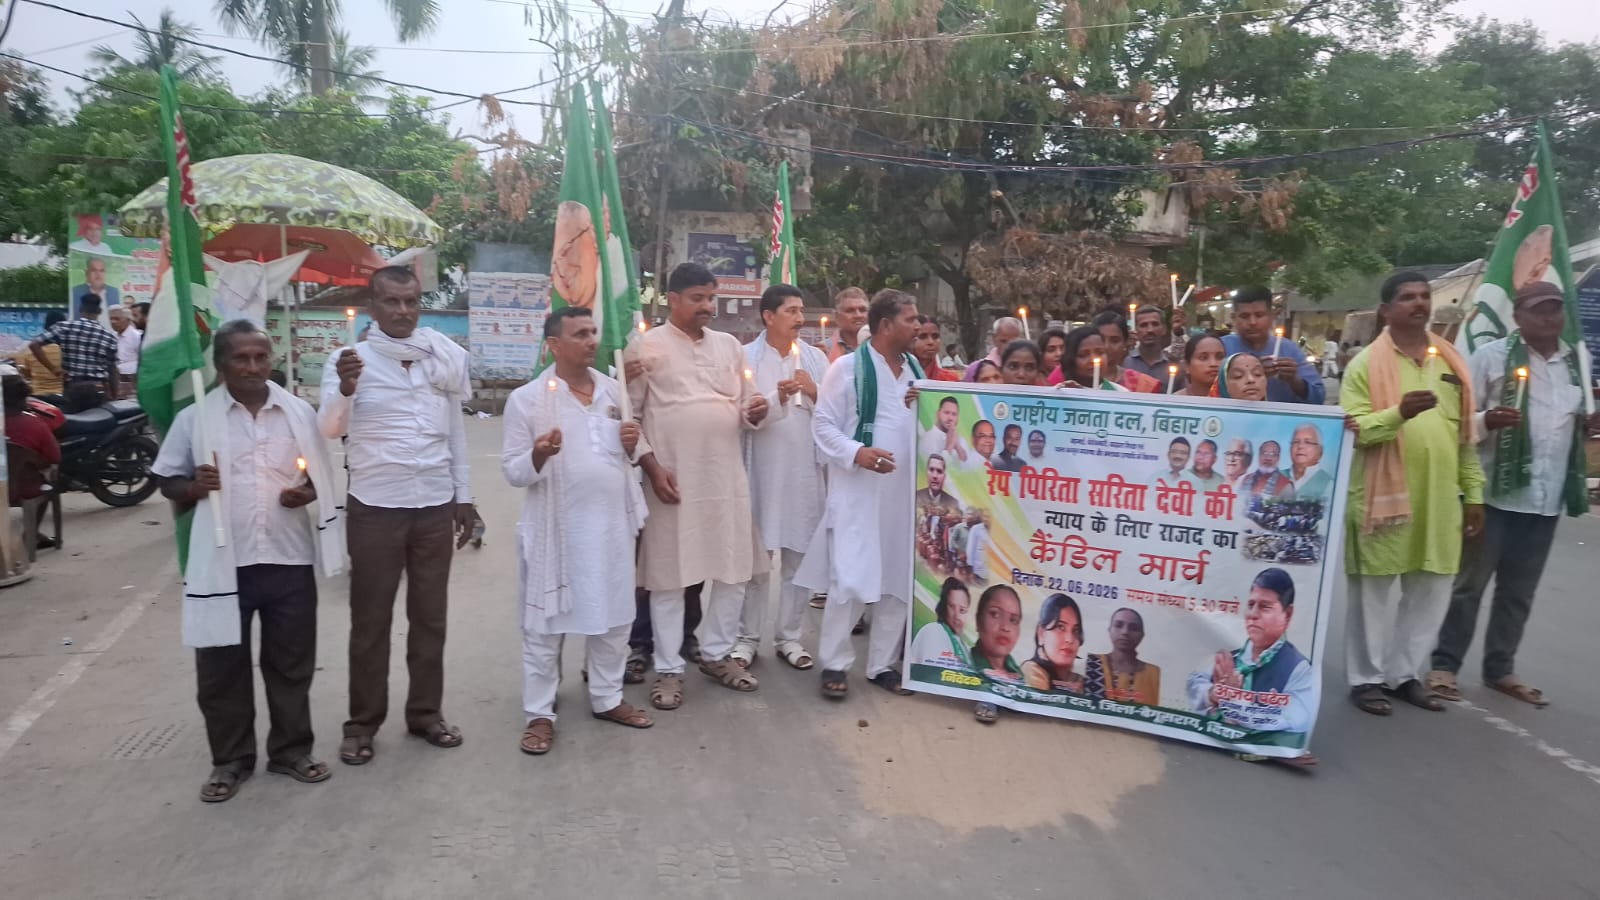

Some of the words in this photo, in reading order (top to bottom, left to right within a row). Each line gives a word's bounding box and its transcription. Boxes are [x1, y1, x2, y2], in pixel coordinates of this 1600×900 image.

[1012, 401, 1059, 425] राष्ट्रीय
[1064, 407, 1110, 428] जनता
[1115, 410, 1147, 434] दल,
[1153, 409, 1201, 435] बिहार
[984, 462, 1012, 497] रेप
[1018, 465, 1081, 504] पिरिता
[1088, 474, 1147, 511] सरिता
[1156, 478, 1196, 516] देवी
[1204, 484, 1236, 520] की
[1045, 510, 1084, 531] न्याय
[1090, 511, 1109, 533] के
[1115, 513, 1152, 539] लिए
[1158, 523, 1205, 545] राजद
[1212, 529, 1239, 549] का
[1029, 528, 1122, 573] कैंडिल
[1139, 549, 1212, 585] मार्च
[1125, 589, 1155, 604] समय
[1156, 590, 1187, 609] संध्या
[1188, 597, 1217, 612] 5.30
[1218, 595, 1240, 615] बजे
[940, 669, 984, 686] निवेदक
[1215, 683, 1256, 703] अजय
[1257, 688, 1291, 707] पटेल
